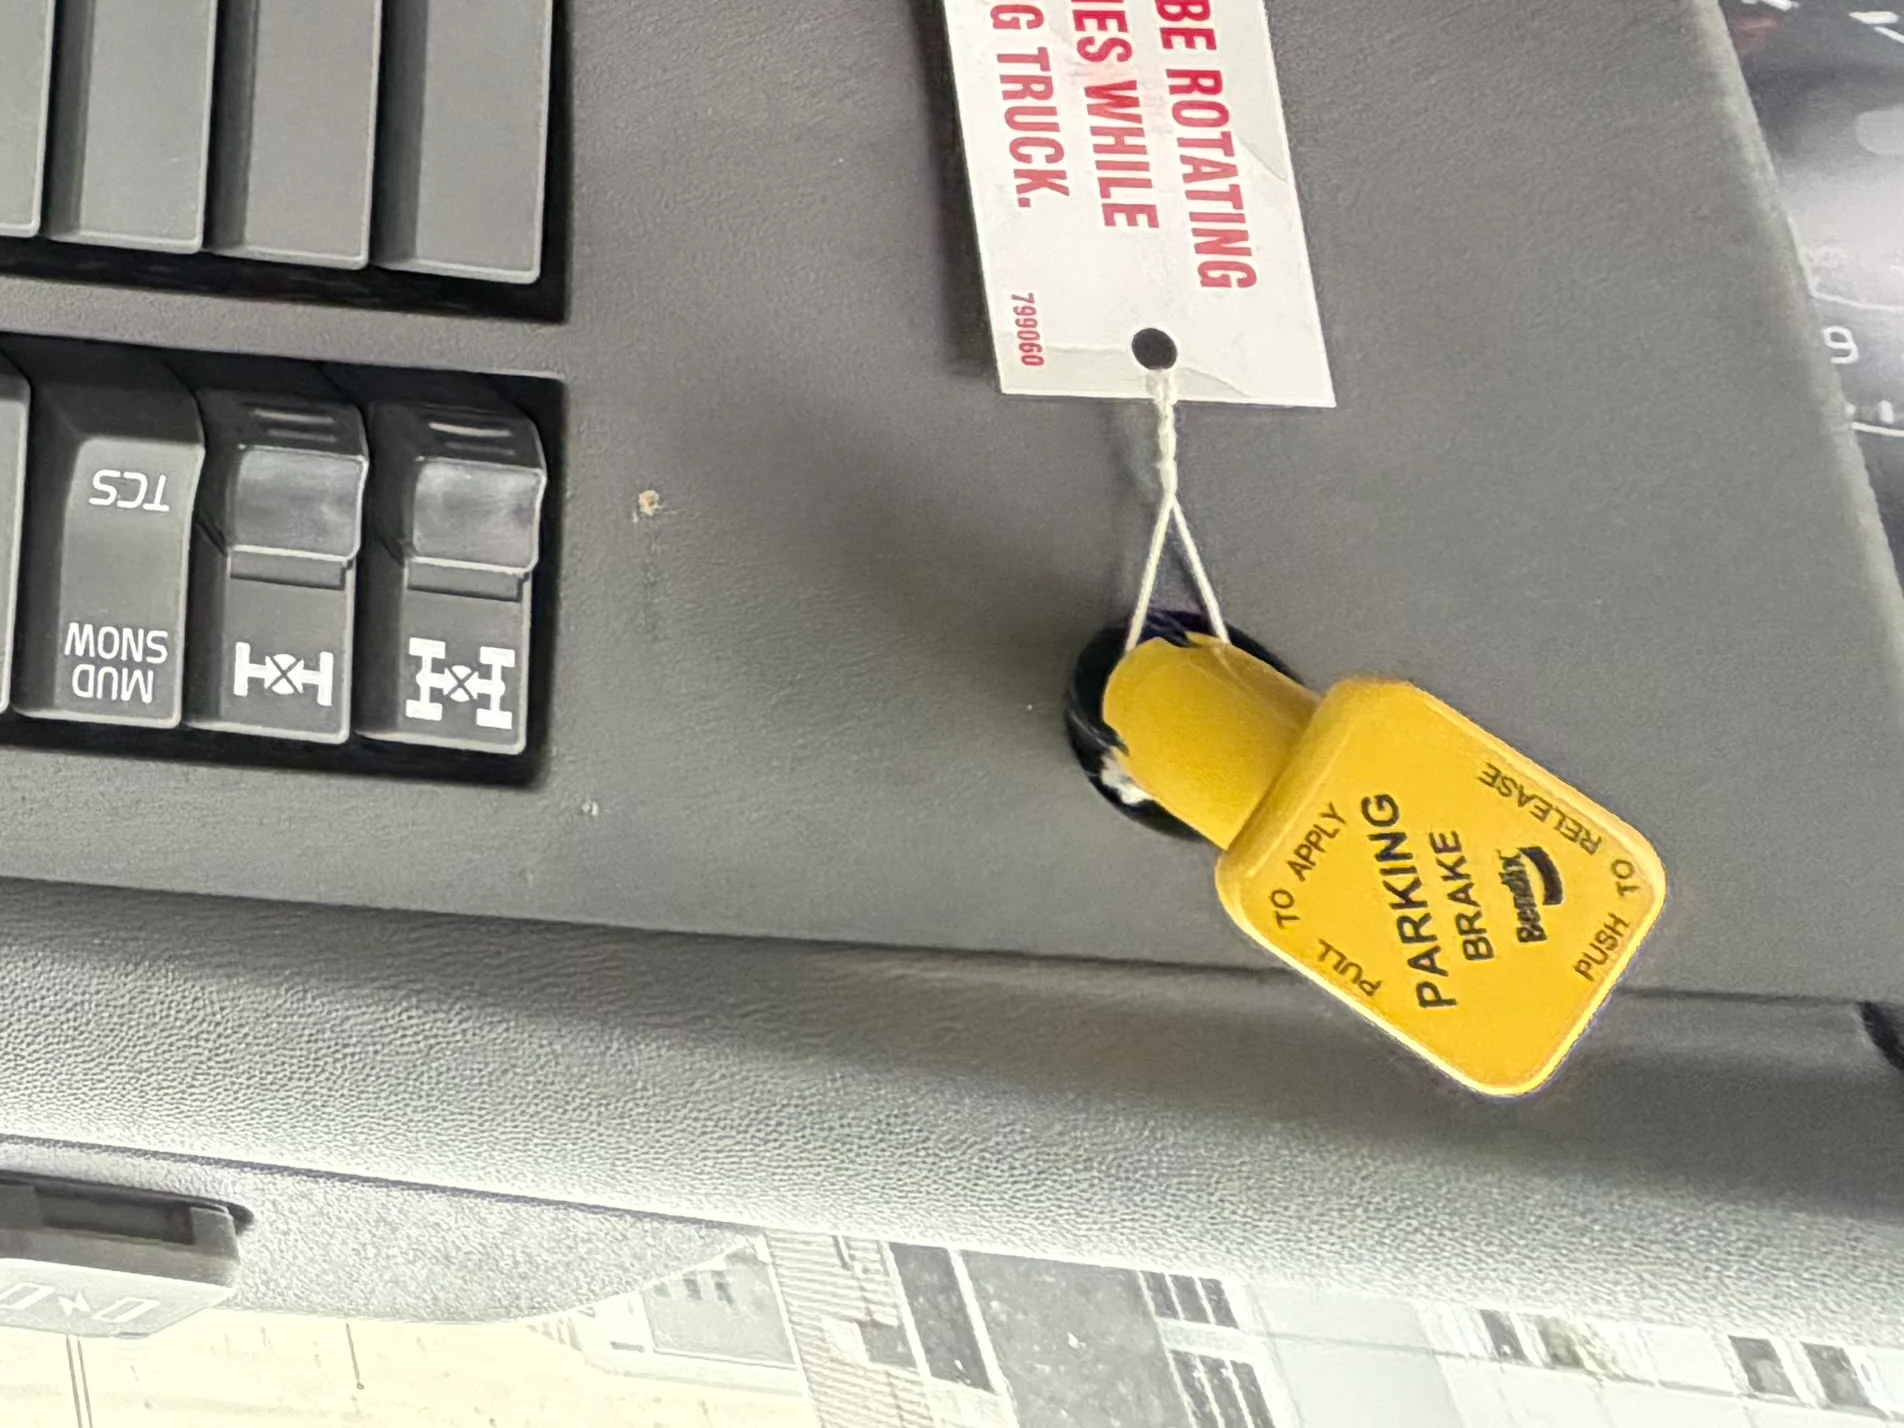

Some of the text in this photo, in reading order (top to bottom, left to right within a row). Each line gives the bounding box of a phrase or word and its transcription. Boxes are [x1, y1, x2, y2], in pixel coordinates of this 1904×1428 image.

[999, 47, 1071, 209] TRUCK.
[1082, 80, 1160, 231] WHILE
[1166, 68, 1258, 290] ROTATING
[1009, 292, 1044, 368] 799060
[88, 469, 170, 512] TCS
[64, 622, 169, 664] SNOW
[72, 663, 154, 704] MUD
[1268, 802, 1383, 998] PULL TO APPLY
[1360, 792, 1458, 1011] PARKING
[1428, 829, 1495, 961] BRAKE
[1475, 761, 1640, 982] PUSH TO RELEASE
[1494, 849, 1547, 944] Bendix
